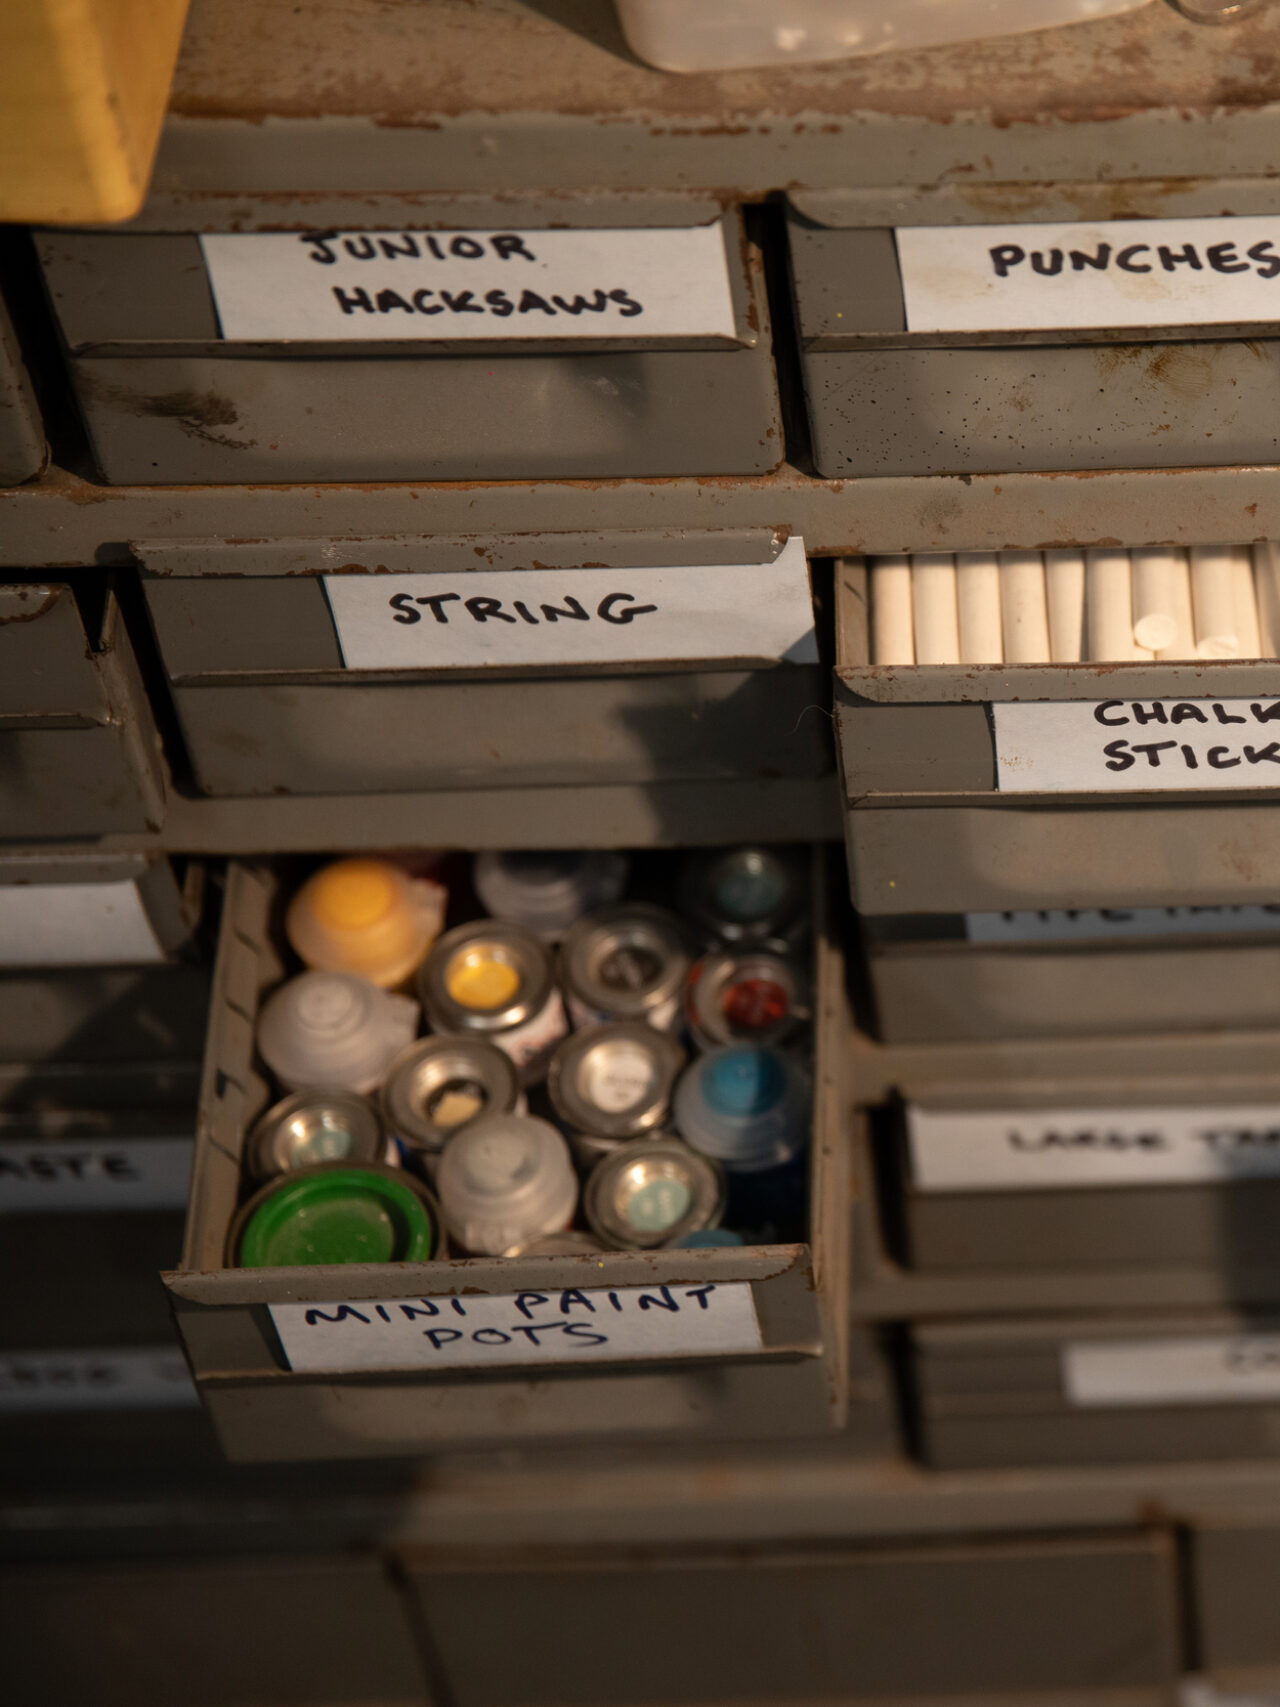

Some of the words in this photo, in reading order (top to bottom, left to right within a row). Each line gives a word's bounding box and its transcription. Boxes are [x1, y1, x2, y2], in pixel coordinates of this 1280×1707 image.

[300, 232, 537, 264] JUNIOR
[332, 285, 644, 318] HACKSAWS
[388, 592, 658, 625] STRING
[304, 1297, 467, 1326] MINI
[513, 1284, 717, 1320] PAINT
[423, 1320, 609, 1350] POTS
